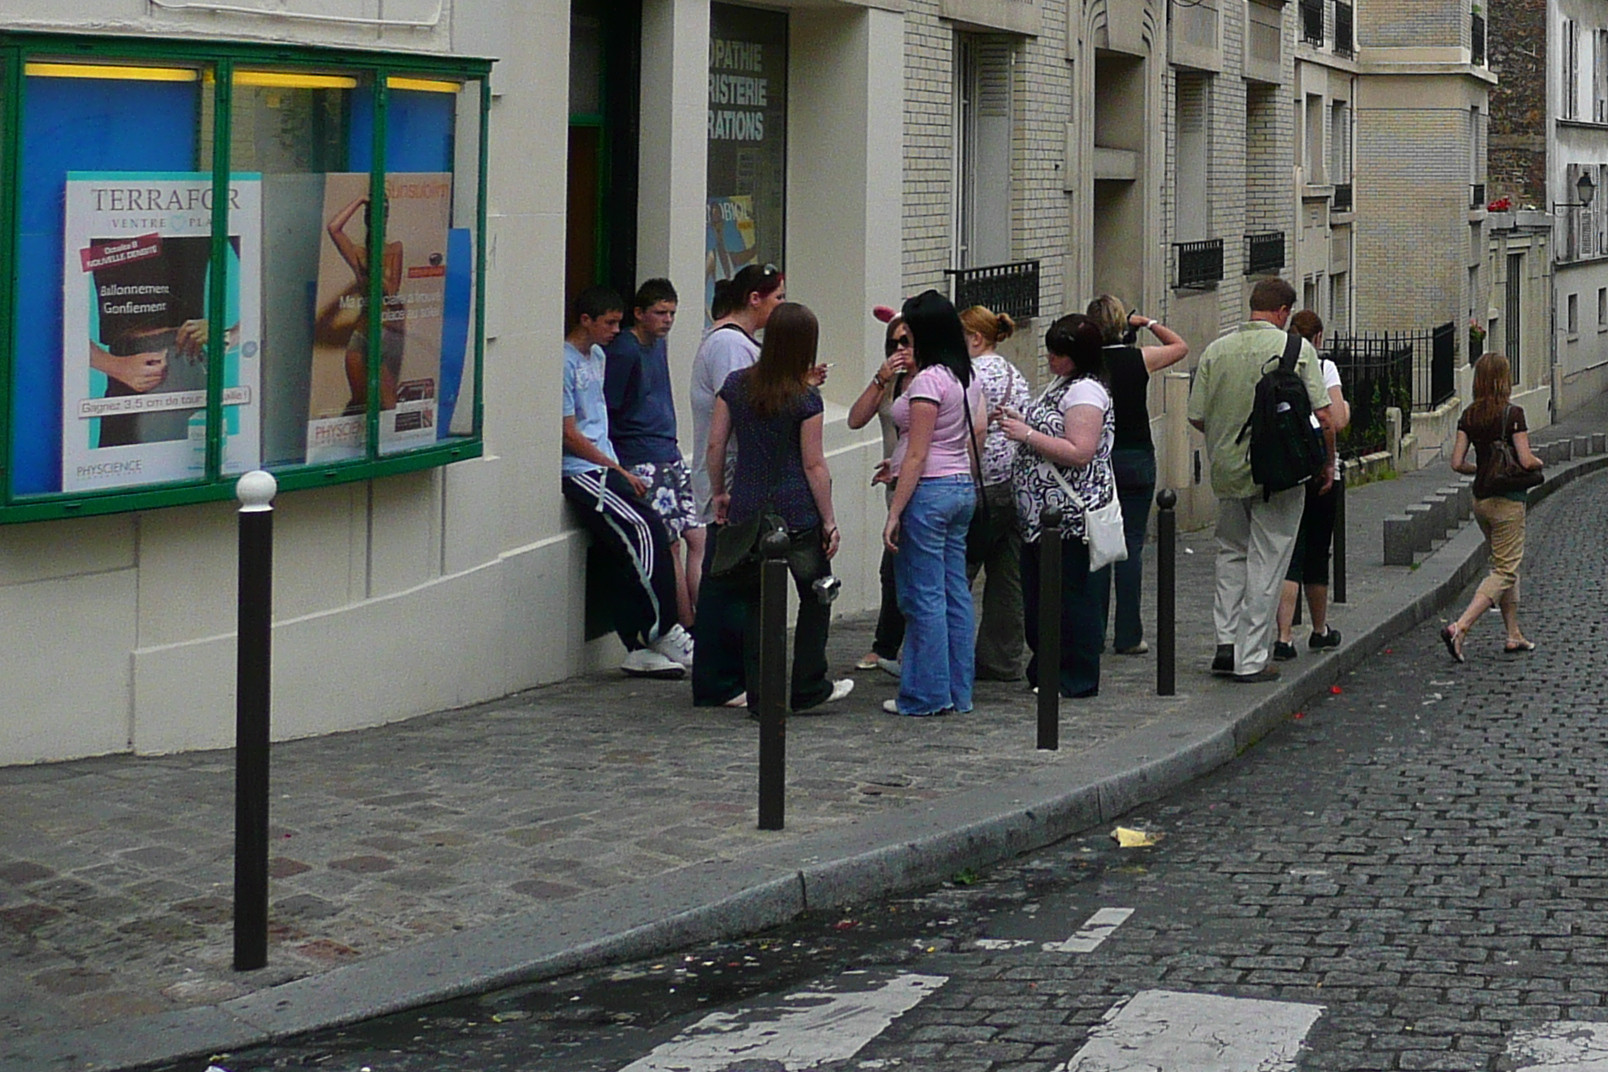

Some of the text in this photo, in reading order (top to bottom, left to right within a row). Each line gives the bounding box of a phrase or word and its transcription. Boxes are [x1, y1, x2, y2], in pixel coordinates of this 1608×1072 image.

[112, 217, 213, 229] VENTRE PLA
[82, 401, 119, 415] Gagnez
[76, 459, 142, 478] PHYSCIENCE
